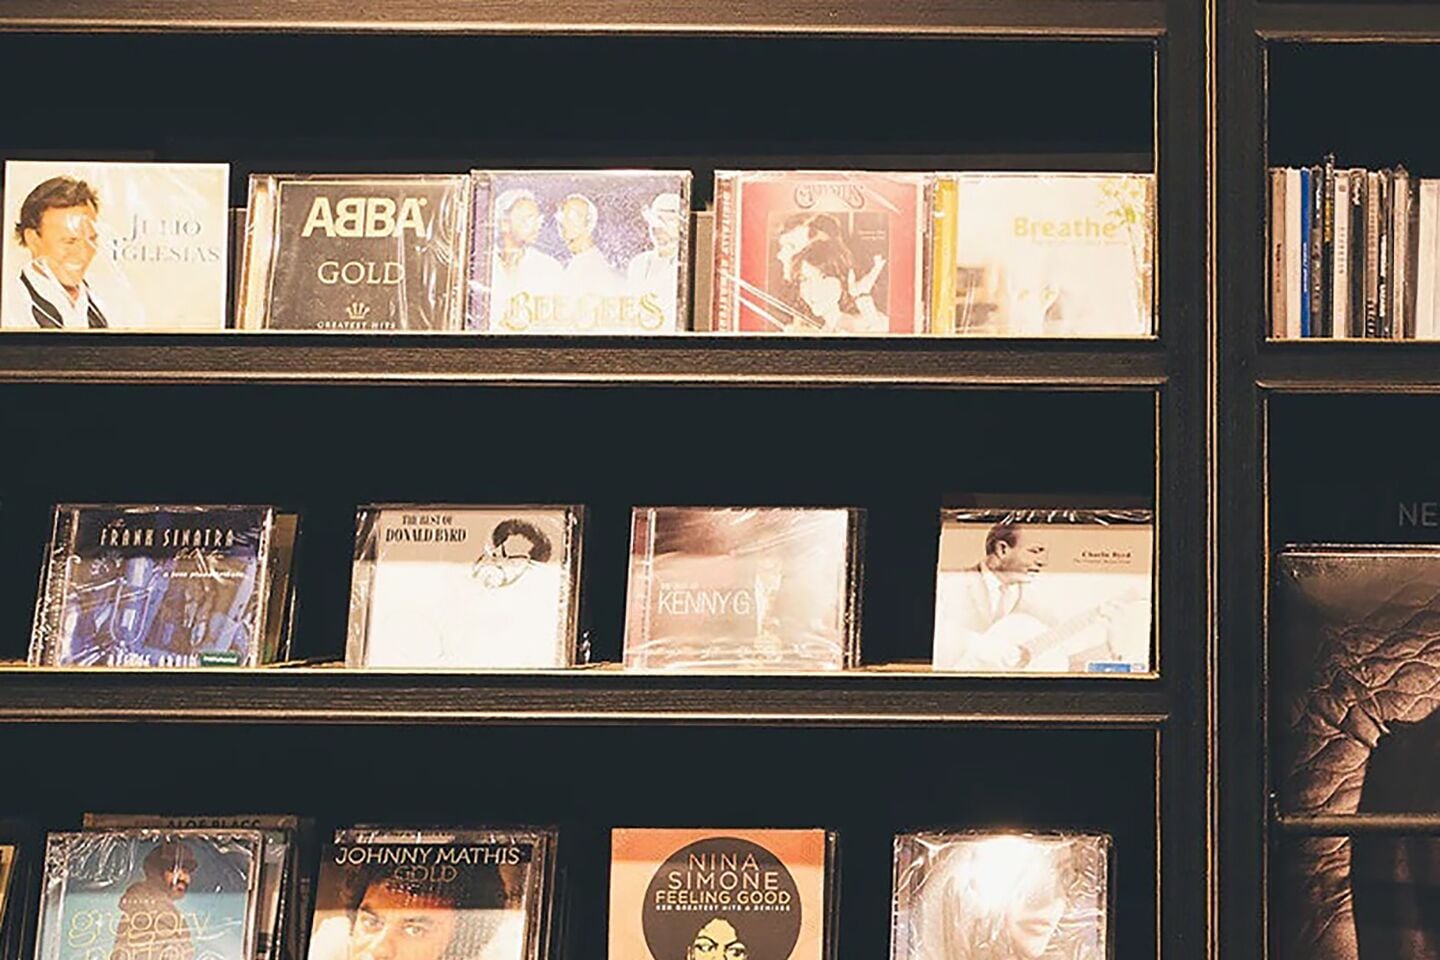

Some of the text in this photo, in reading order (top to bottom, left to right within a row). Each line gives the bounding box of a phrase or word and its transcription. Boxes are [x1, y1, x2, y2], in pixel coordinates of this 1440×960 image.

[301, 197, 427, 237] ABBA
[1013, 215, 1118, 238] Breathe
[317, 261, 405, 284] GOLD
[316, 321, 366, 329] GREATEST
[100, 528, 234, 547] FRANK SINATRA
[385, 528, 467, 542] DONALD BYRD
[658, 590, 751, 615] KENNY G
[334, 847, 522, 865] JOHNNY MATHIS
[689, 853, 760, 871] NINA
[394, 865, 459, 882] GOLD
[668, 871, 779, 890] SIMONE
[655, 890, 791, 905] FEELING GOOD
[68, 909, 210, 948] gregory
